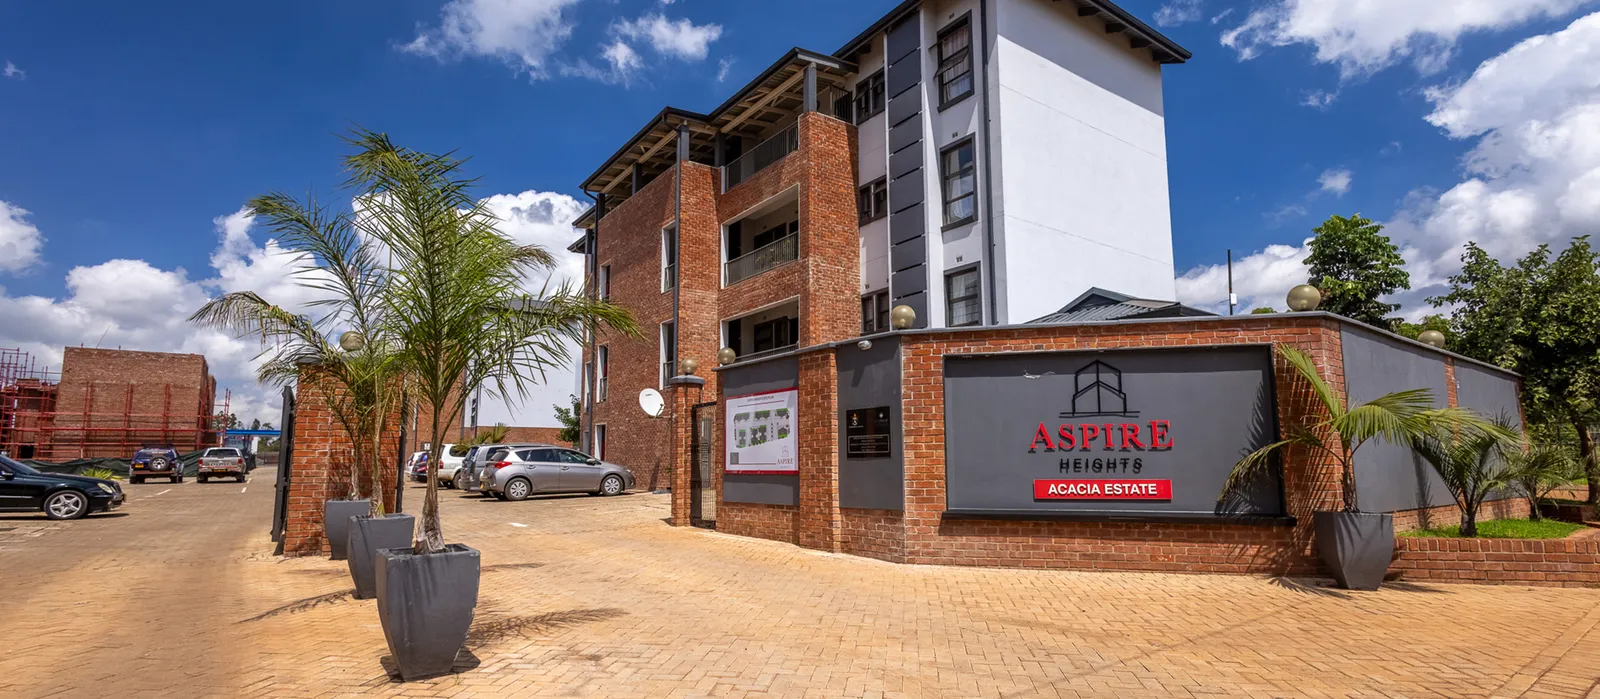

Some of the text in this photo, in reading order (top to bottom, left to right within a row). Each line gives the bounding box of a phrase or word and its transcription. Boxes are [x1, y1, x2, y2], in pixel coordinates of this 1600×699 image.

[1029, 419, 1174, 450] ASPIRE
[1059, 457, 1143, 472] HEIGHTS
[1048, 483, 1158, 495] ACACIA ESTATE
